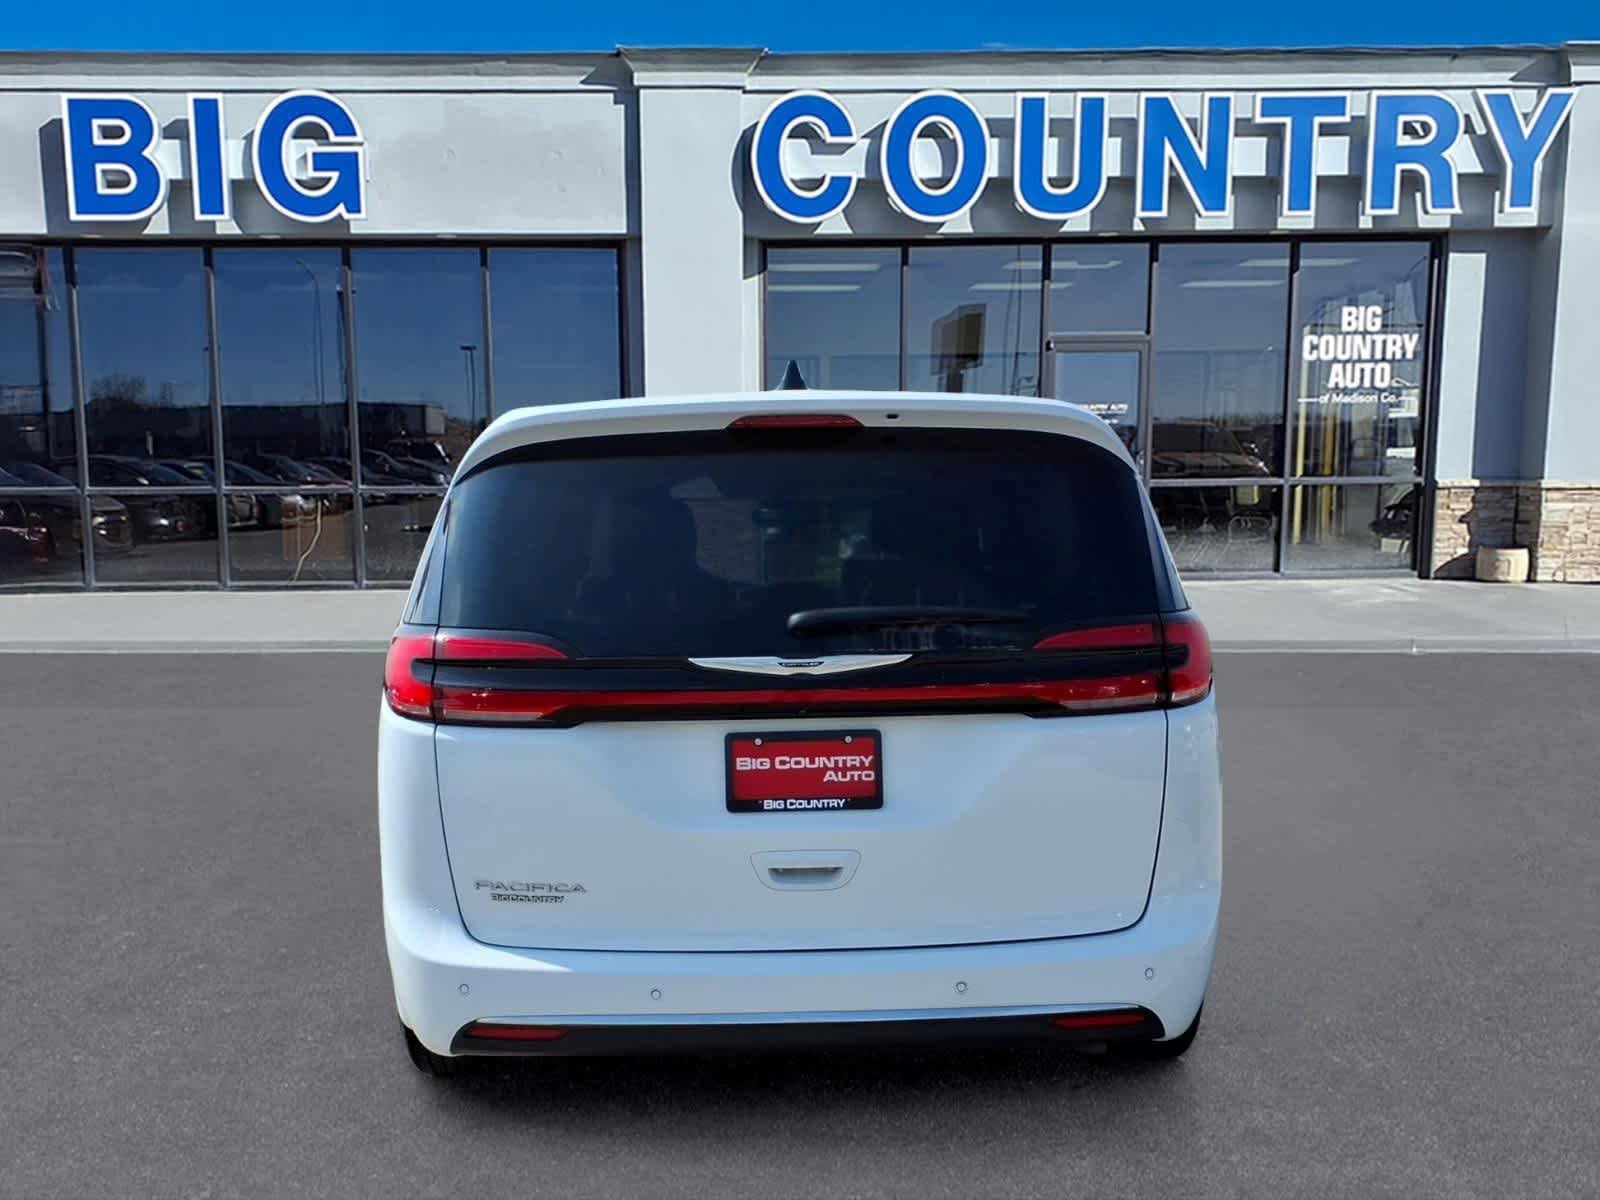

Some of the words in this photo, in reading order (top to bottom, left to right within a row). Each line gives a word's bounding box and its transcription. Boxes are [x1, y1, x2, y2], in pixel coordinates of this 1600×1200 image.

[61, 89, 367, 222] BIG
[750, 88, 1575, 224] COUNTRY
[1341, 305, 1382, 332] BIG
[1302, 334, 1419, 361] COUNTRY
[1328, 362, 1391, 388] AUTO
[736, 757, 771, 770] BIG
[775, 755, 874, 769] COUNTRY
[823, 770, 876, 782] AUTO
[763, 800, 785, 810] BIG
[786, 799, 846, 809] COUNTRY
[474, 880, 588, 893] PACIFICA
